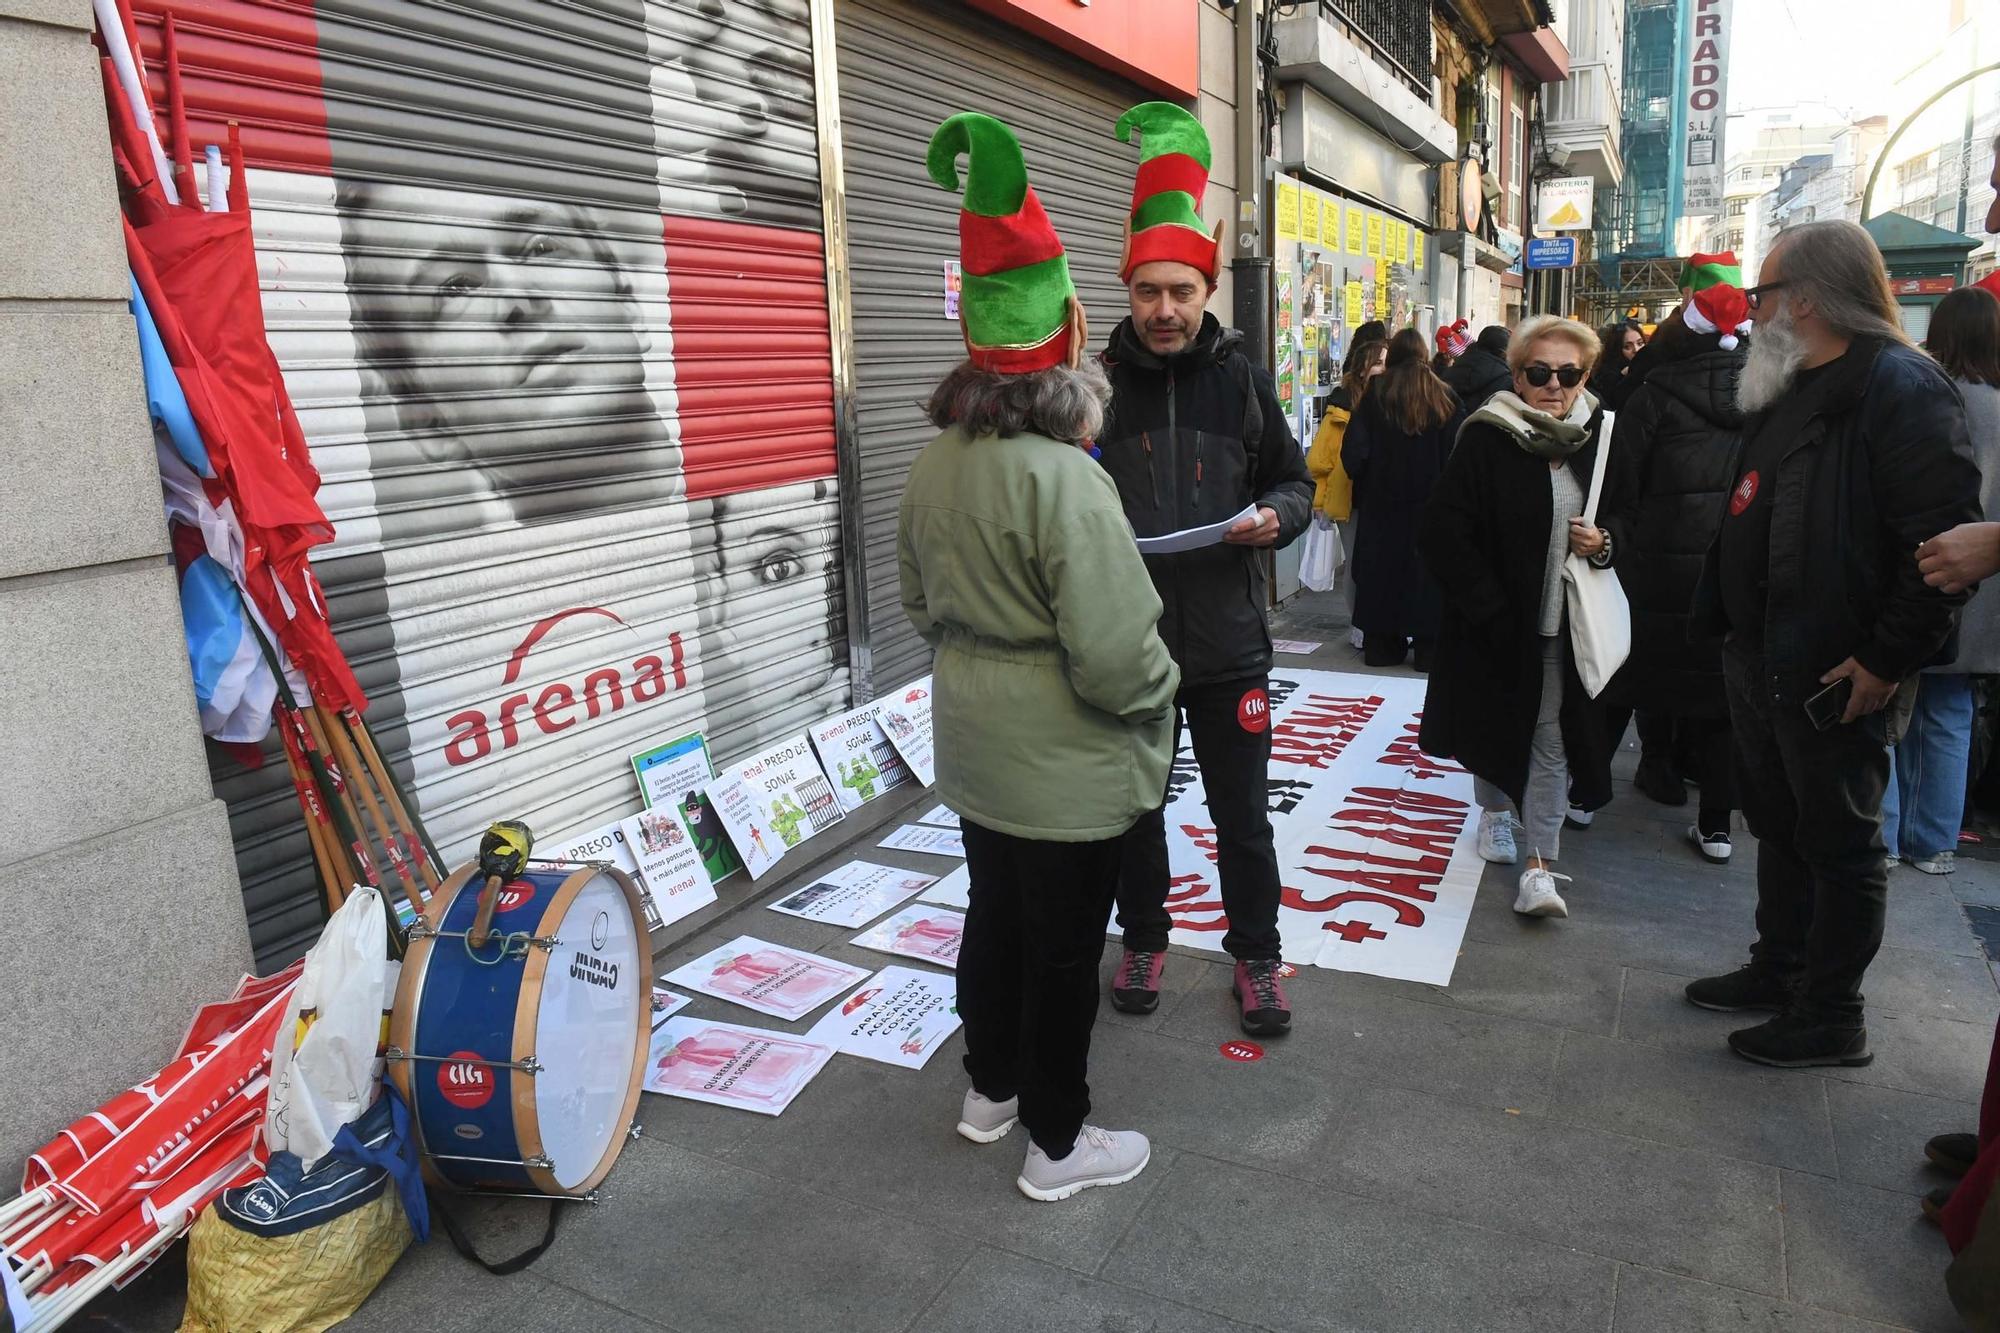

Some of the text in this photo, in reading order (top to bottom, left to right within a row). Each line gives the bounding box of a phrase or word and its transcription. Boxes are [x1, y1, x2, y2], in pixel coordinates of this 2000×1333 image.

[1543, 240, 1560, 248] TINTA
[444, 631, 688, 767] arenal
[820, 721, 848, 742] arenal
[846, 711, 871, 730] PRESO
[845, 731, 873, 752] SONAE
[764, 748, 794, 768] PRESO
[795, 742, 808, 756] DE
[764, 769, 798, 793] SONAE
[569, 835, 613, 861] PRESO
[644, 846, 693, 873] Menos postureo
[658, 868, 674, 881] máis
[674, 858, 696, 874] diñeiro
[669, 875, 697, 896] arenal
[742, 973, 784, 996] QUEREMOS
[753, 987, 773, 999] NON
[851, 977, 921, 1036] PARAUGAS DE
[867, 984, 929, 1037] AGASALLO A
[882, 993, 931, 1036] COSTA DO
[900, 997, 943, 1032] SALARIO
[449, 1063, 483, 1085] CIG
[704, 1056, 742, 1090] QUEREMOS
[718, 1076, 738, 1092] NON
